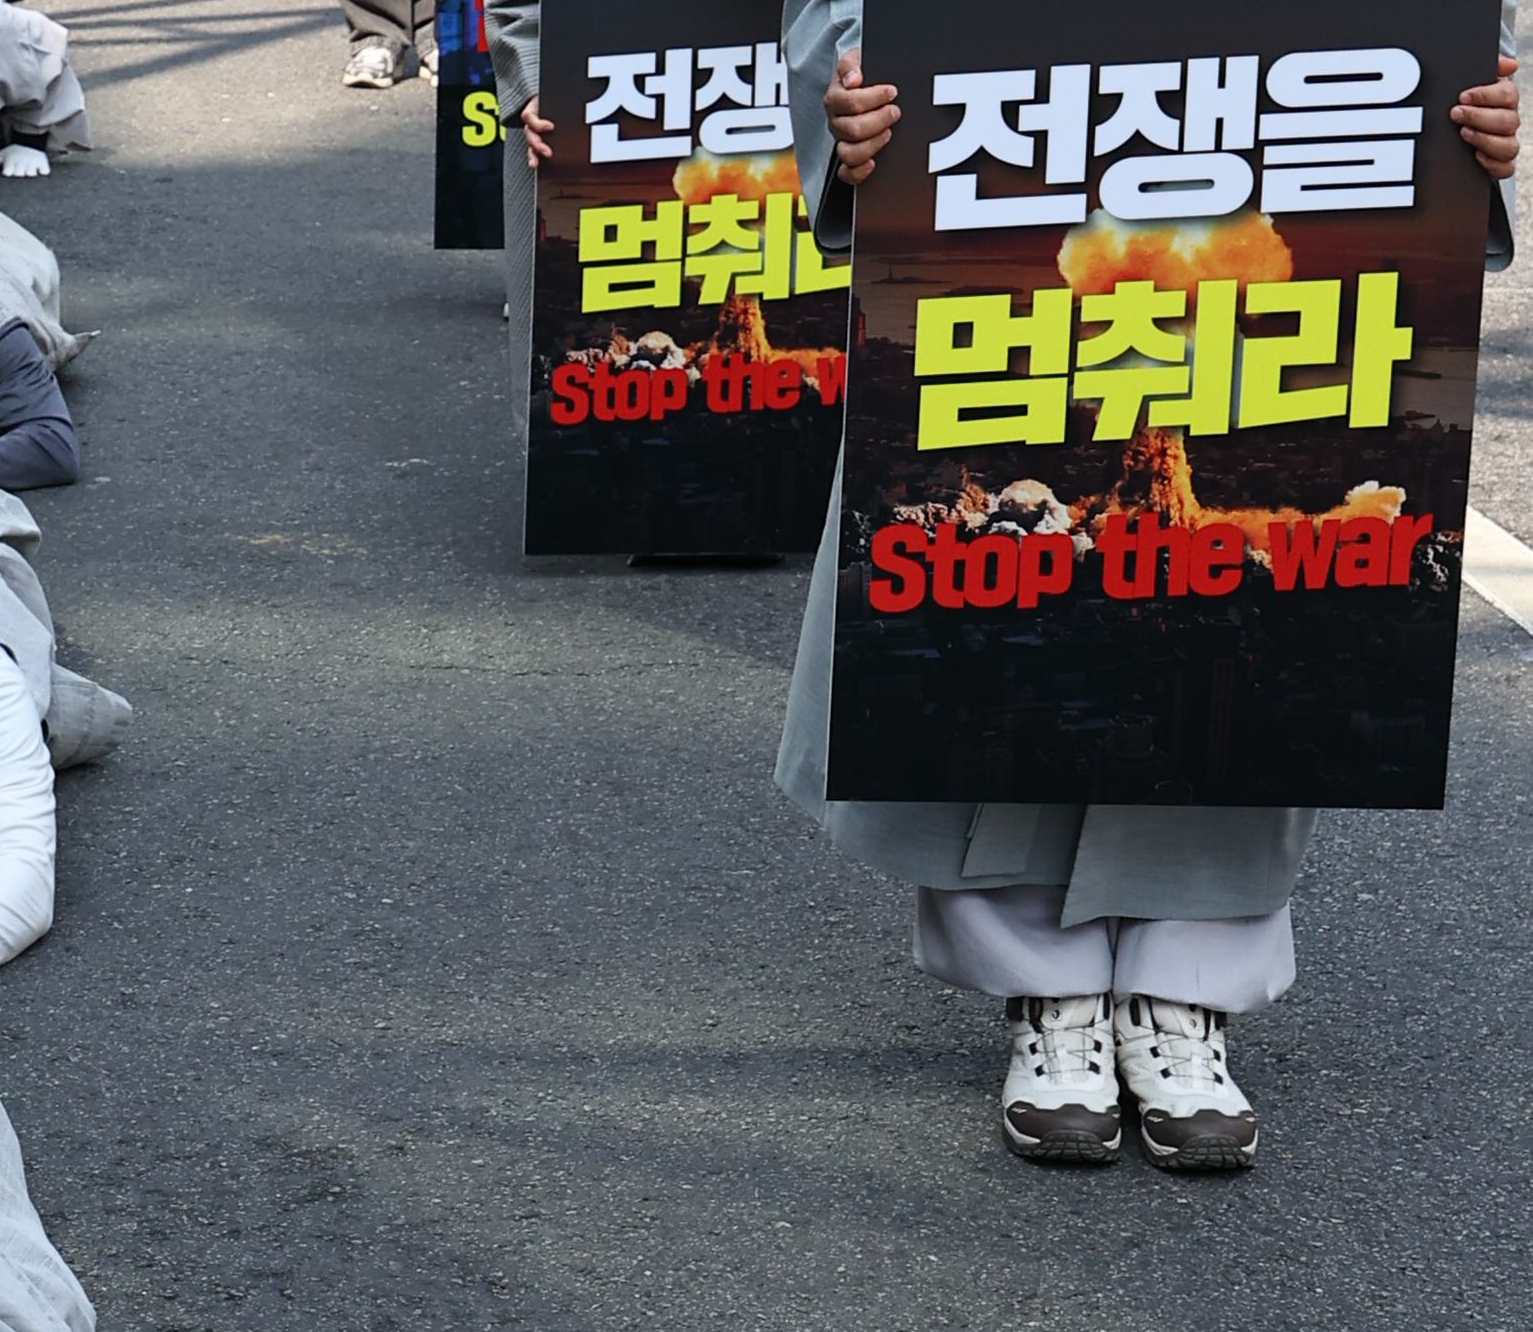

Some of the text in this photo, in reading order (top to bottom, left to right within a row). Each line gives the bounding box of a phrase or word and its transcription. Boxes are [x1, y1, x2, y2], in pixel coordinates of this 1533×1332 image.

[585, 41, 795, 164] 전쟁
[927, 48, 1424, 233] 전쟁을
[550, 361, 688, 425] Stop
[702, 350, 802, 414] the
[914, 271, 1413, 451] 멈춰라
[868, 512, 1433, 614] Stop the war
